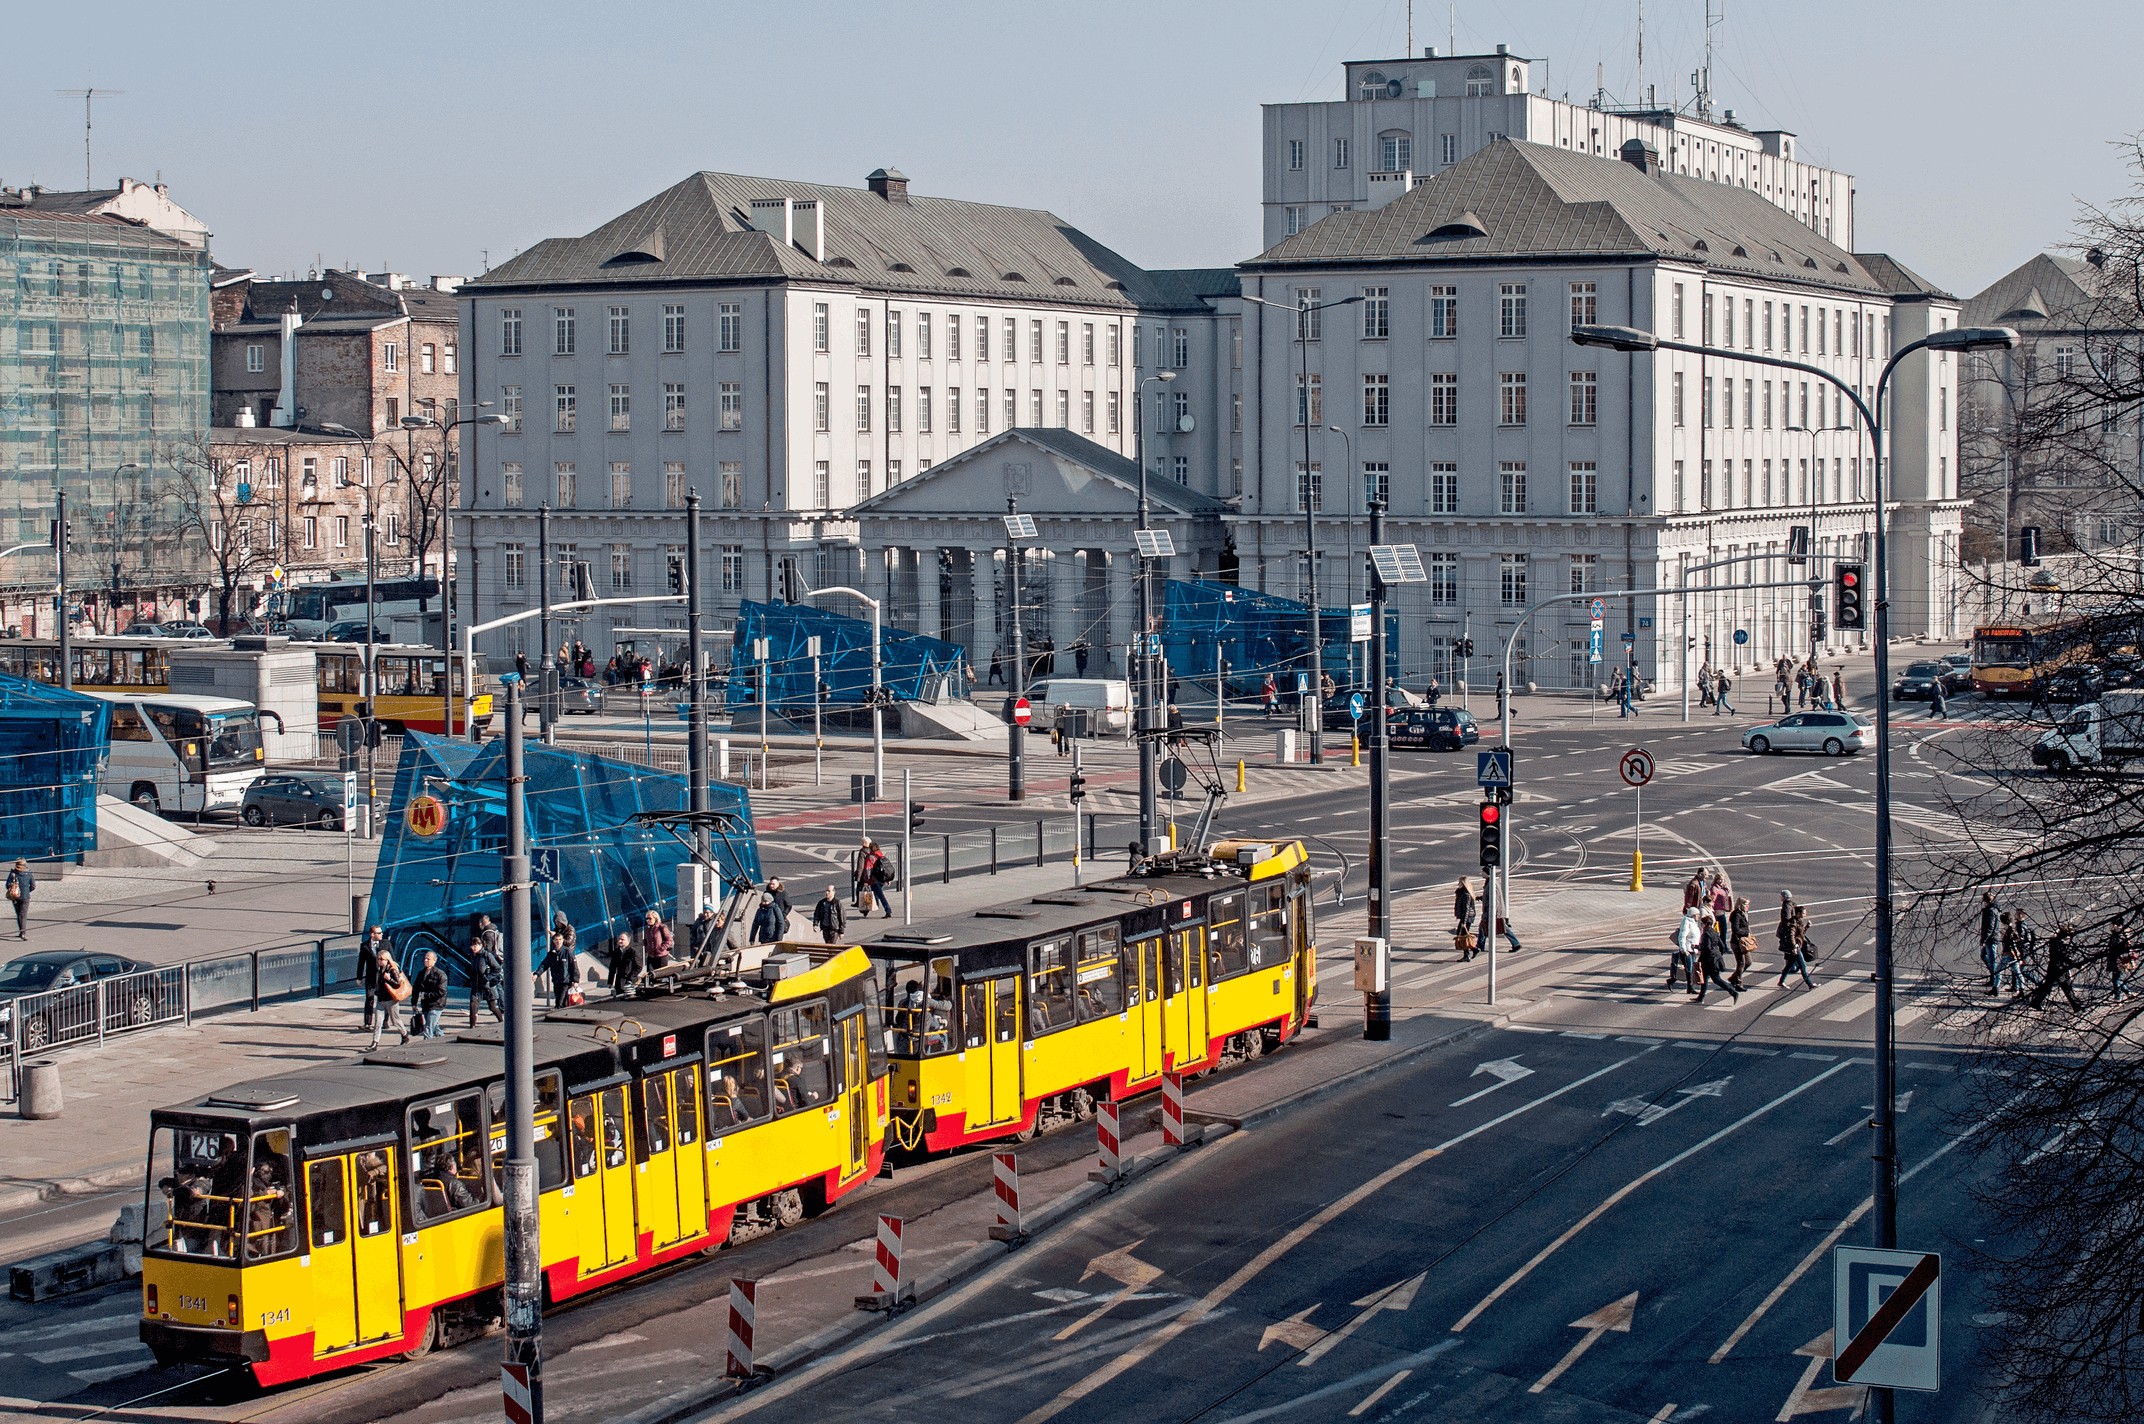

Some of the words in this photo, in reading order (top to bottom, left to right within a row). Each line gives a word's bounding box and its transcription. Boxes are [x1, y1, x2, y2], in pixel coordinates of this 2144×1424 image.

[349, 781, 355, 806] P
[412, 803, 436, 829] M
[931, 1091, 953, 1106] 1342
[193, 1135, 220, 1159] 26
[178, 1294, 208, 1312] 1341
[260, 1307, 292, 1327] 1341
